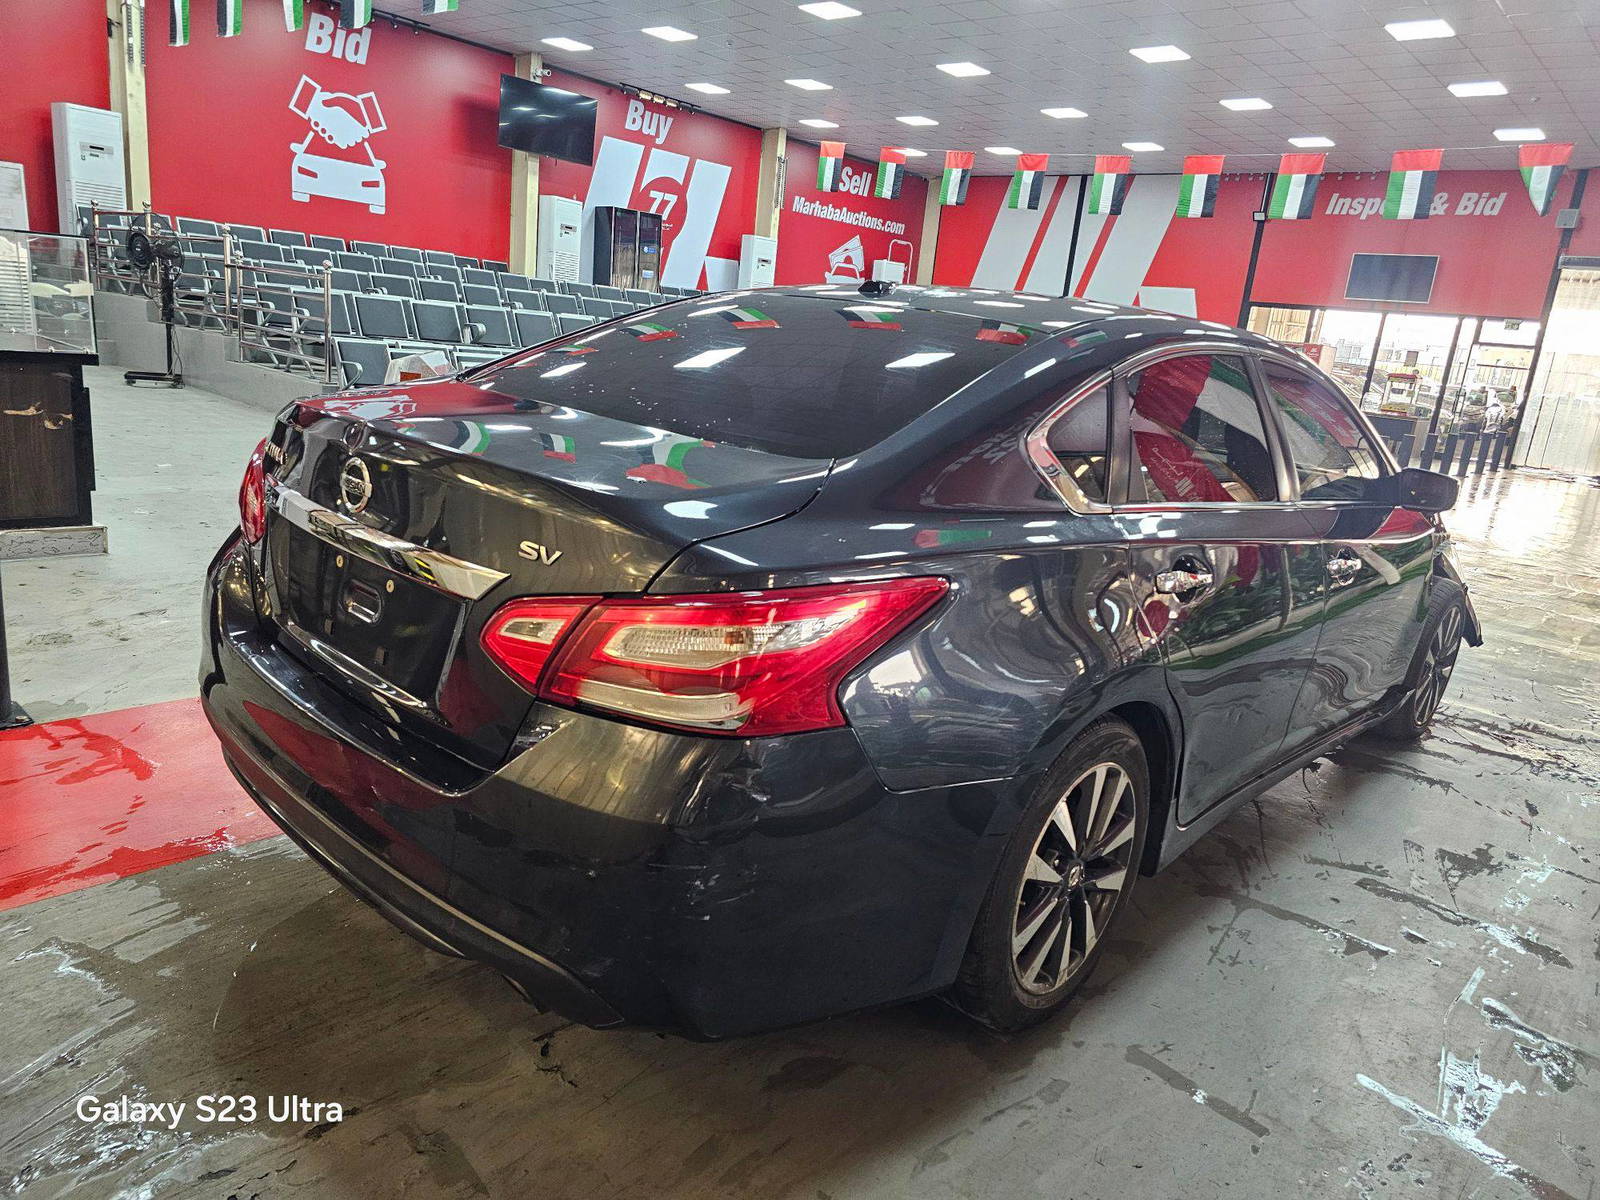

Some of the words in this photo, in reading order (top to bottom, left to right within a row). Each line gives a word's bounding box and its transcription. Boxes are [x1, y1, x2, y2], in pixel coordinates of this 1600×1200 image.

[304, 12, 372, 65] Bid
[625, 99, 674, 145] Buy
[839, 166, 872, 197] Sell
[649, 190, 678, 221] 77
[792, 195, 906, 235] MarhabaAuctions.com
[1325, 193, 1386, 220] Insp
[1430, 192, 1449, 216] &
[1454, 192, 1507, 216] Bid
[518, 540, 563, 566] SV
